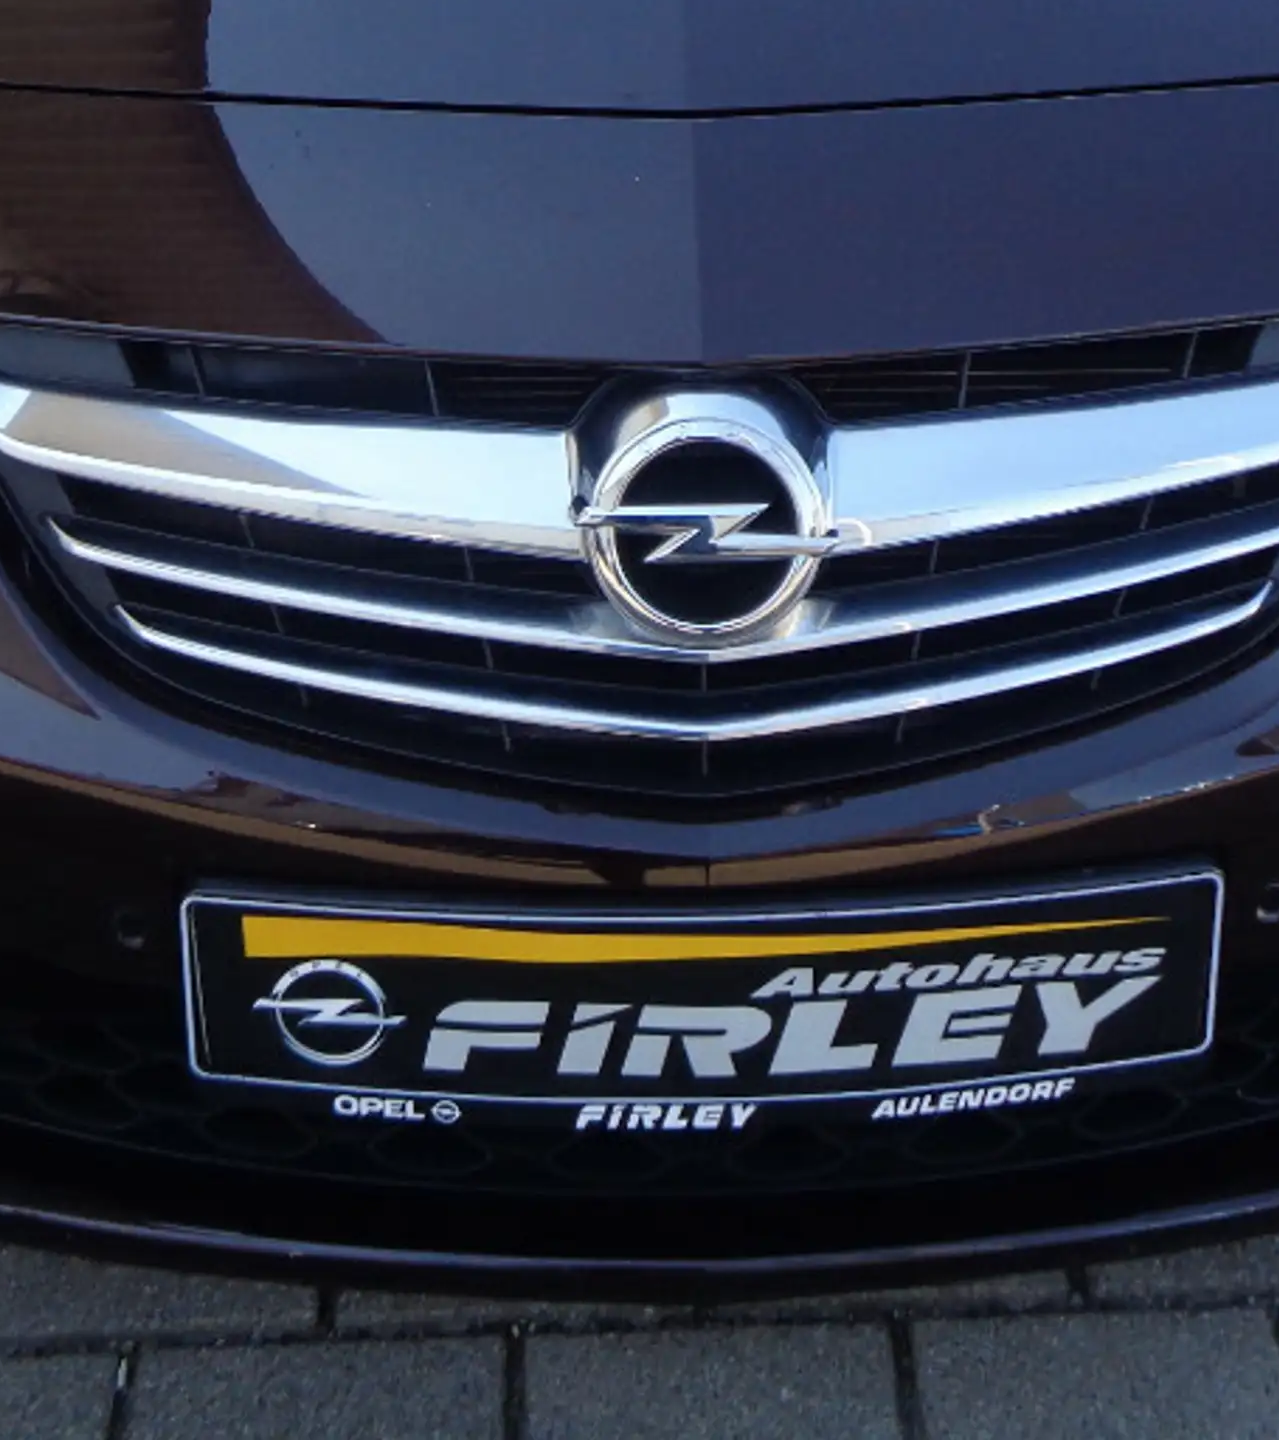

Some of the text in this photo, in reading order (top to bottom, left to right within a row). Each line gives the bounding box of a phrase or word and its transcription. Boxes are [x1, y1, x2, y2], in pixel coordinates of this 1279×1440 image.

[750, 947, 1167, 998] Autohaus
[423, 976, 1161, 1077] FIRLEY
[333, 1094, 426, 1121] OPEL
[576, 1103, 758, 1130] FIRLEY
[871, 1077, 1075, 1120] AULENDORF
